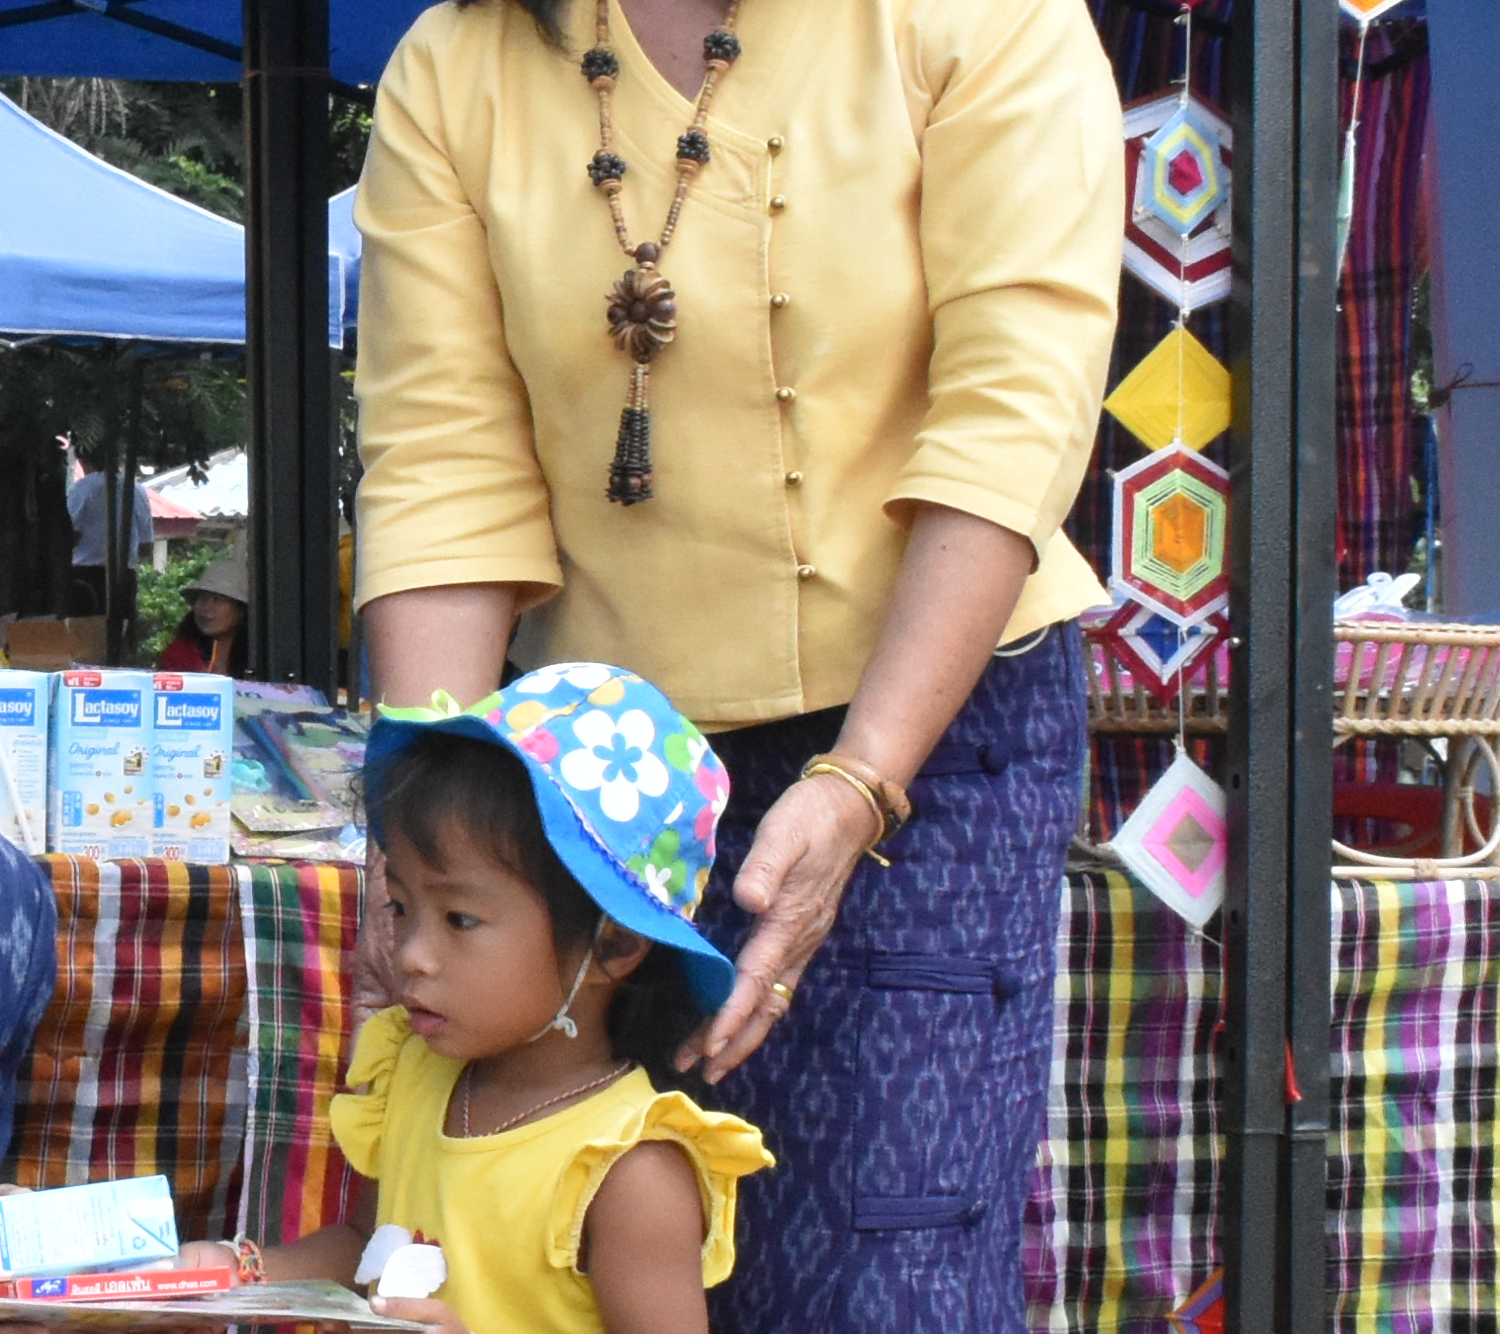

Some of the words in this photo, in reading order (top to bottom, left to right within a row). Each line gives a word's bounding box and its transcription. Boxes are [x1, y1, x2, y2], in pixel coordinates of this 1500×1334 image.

[74, 693, 139, 723] Lactasoy
[157, 696, 219, 726] Lactasoy
[69, 742, 121, 760] Original
